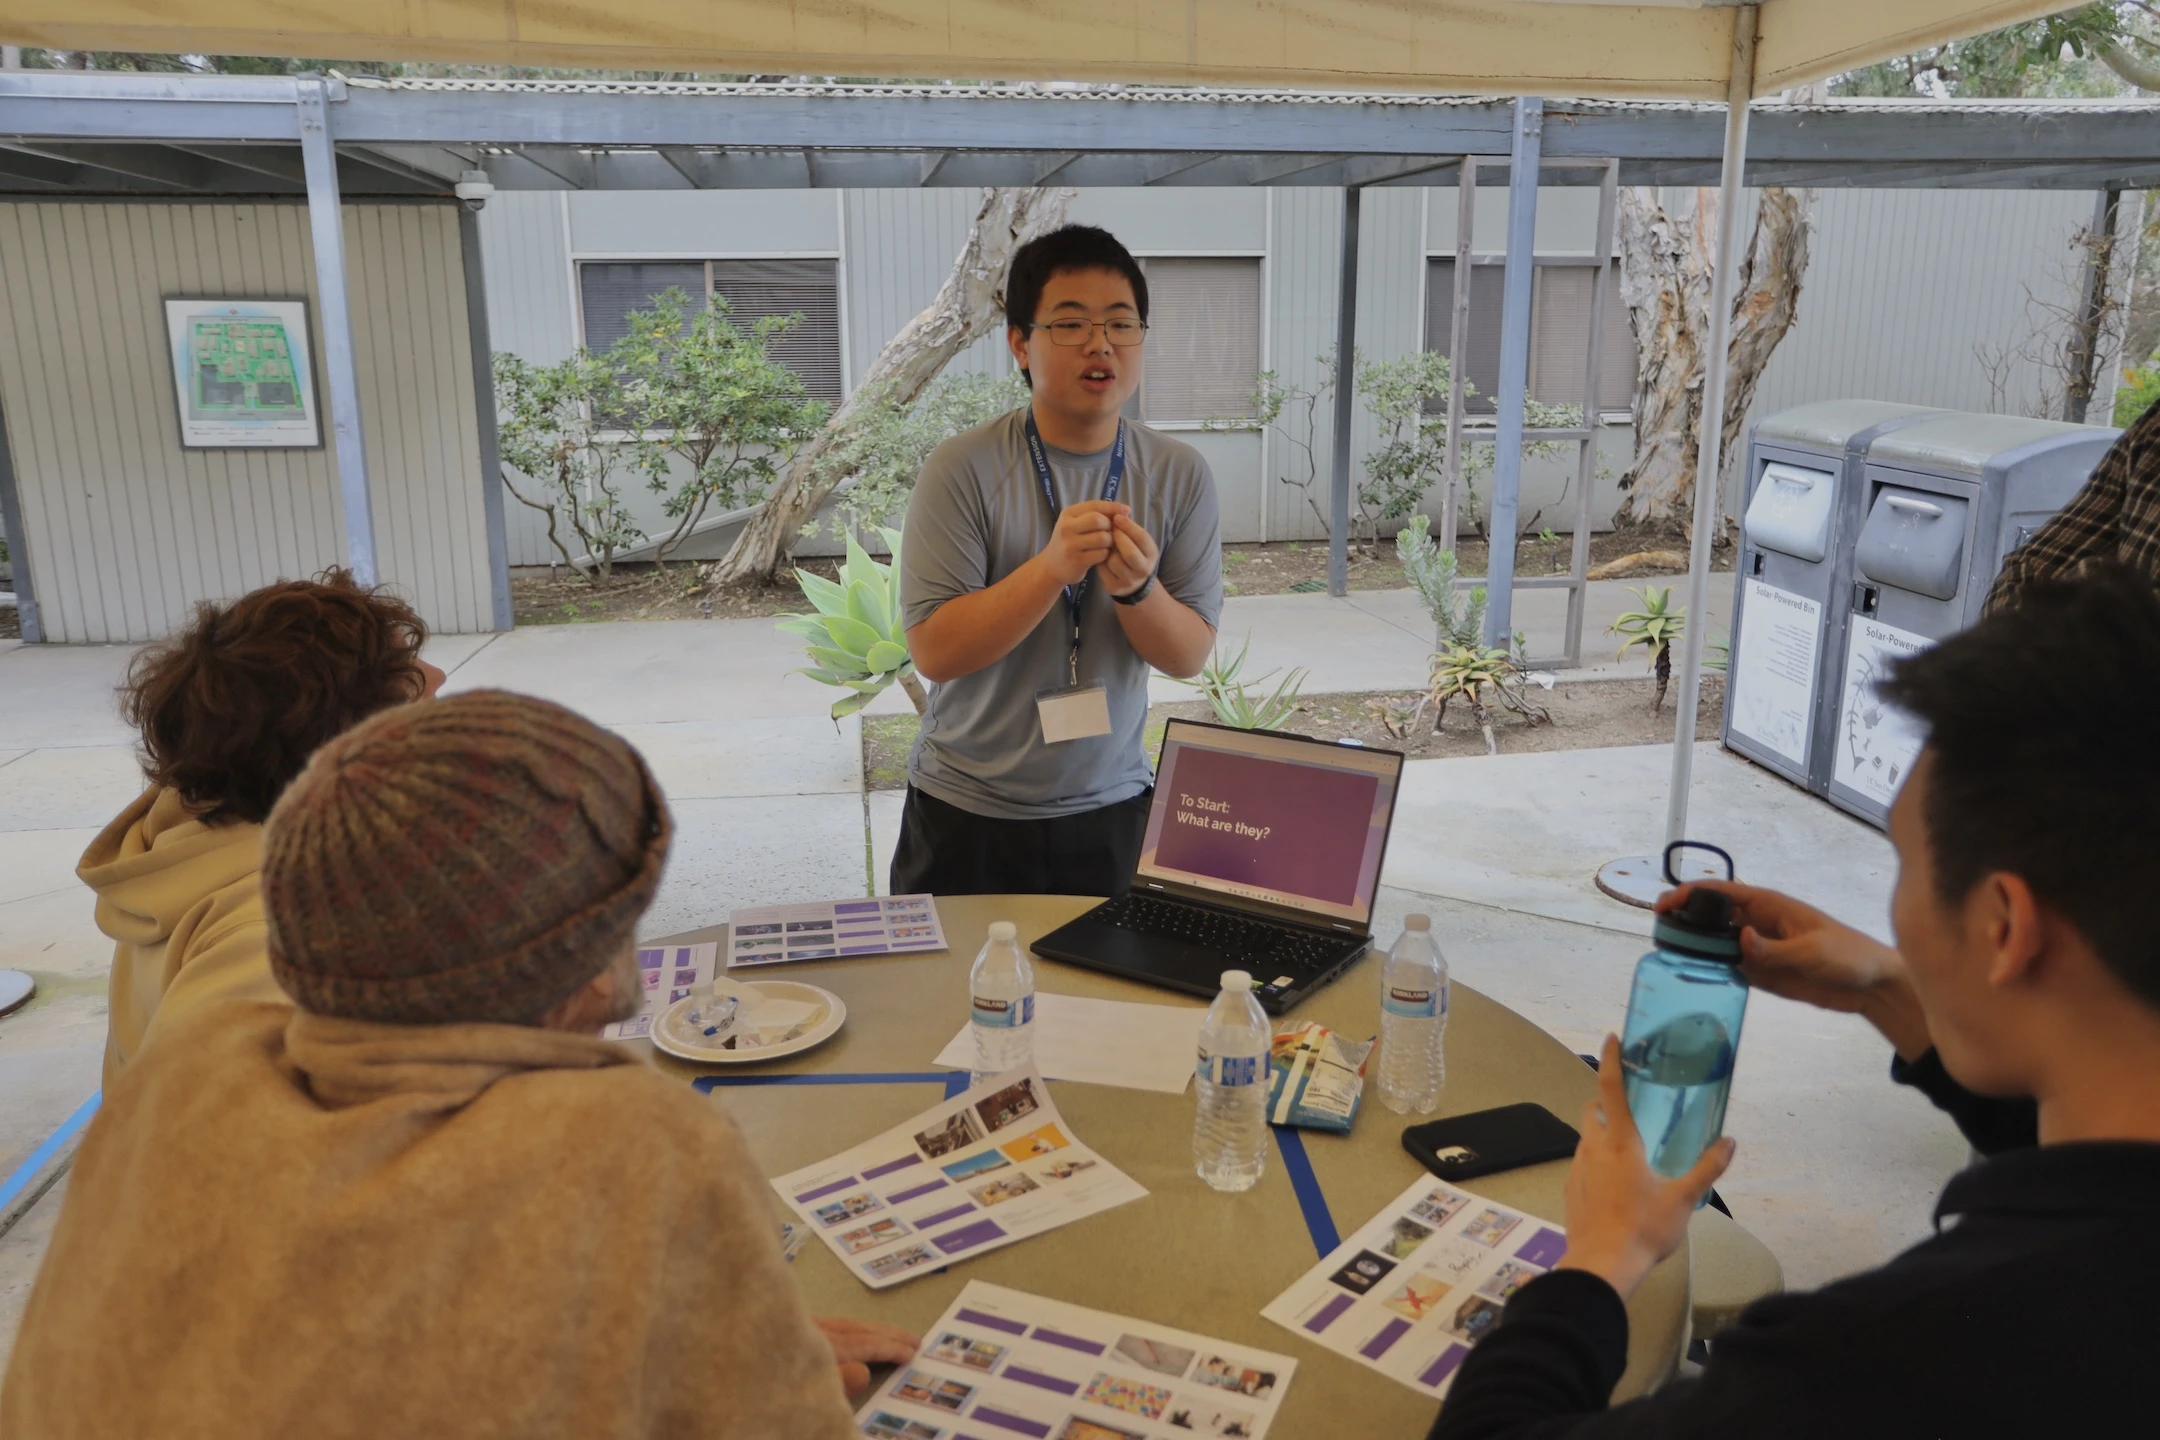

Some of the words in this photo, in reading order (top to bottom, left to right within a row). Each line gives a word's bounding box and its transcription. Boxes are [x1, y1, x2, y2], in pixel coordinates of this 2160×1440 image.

[1031, 435, 1046, 472] EXTENSION
[1756, 585, 1803, 610] Solar-Powered
[1803, 602, 1815, 614] Bin
[1180, 793, 1194, 807] To
[1196, 797, 1230, 814] Start:
[1176, 810, 1209, 828] What
[1211, 820, 1233, 832] are
[1235, 822, 1270, 841] they?
